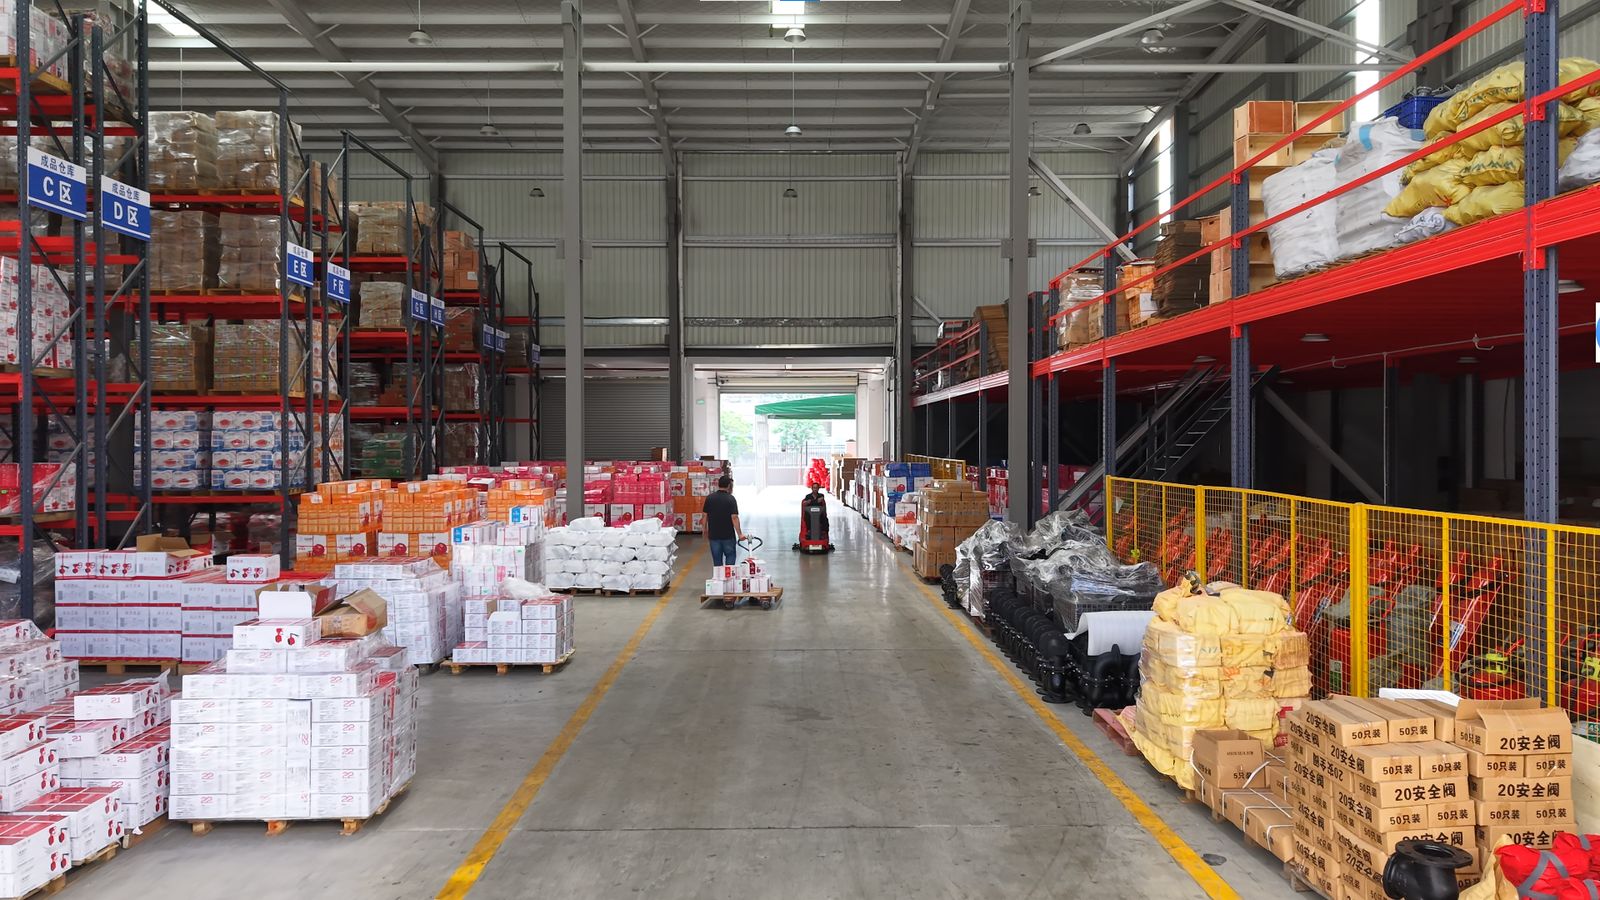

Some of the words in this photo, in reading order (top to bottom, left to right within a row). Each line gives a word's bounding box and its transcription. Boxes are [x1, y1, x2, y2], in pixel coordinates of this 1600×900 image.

[41, 154, 75, 178] 成品仓库
[43, 176, 73, 205] C区
[111, 182, 140, 201] 成品仓库
[113, 201, 140, 228] D区
[294, 260, 307, 278] E区
[333, 279, 345, 295] F区
[1306, 711, 1336, 739] 20安全阀
[1399, 725, 1428, 736] 50只装
[1289, 720, 1320, 748] 20安全阀
[1352, 729, 1381, 740] 50只装
[1460, 731, 1481, 746] 50只装
[1500, 734, 1561, 751] 20安全阀
[1312, 752, 1344, 782] 20安全阀
[1330, 745, 1365, 775] 20安全阀
[1432, 761, 1462, 773] 50只装
[1487, 762, 1517, 772] 50只装
[341, 771, 354, 779] 22
[1294, 761, 1324, 789] 20安全阀
[1382, 764, 1413, 776] 50只装
[1394, 783, 1456, 801] 20安全阀
[1498, 782, 1560, 798] 20安全阀
[200, 796, 213, 804] 22
[341, 795, 354, 803] 22
[1338, 791, 1373, 823] 20安全阀
[1298, 801, 1325, 831] 20安全阀
[1389, 813, 1421, 825] 50只装
[1437, 808, 1469, 821] 50只装
[1490, 809, 1520, 820] 50只装
[1536, 808, 1567, 818] 50只装
[1295, 840, 1326, 872] 20安全阀
